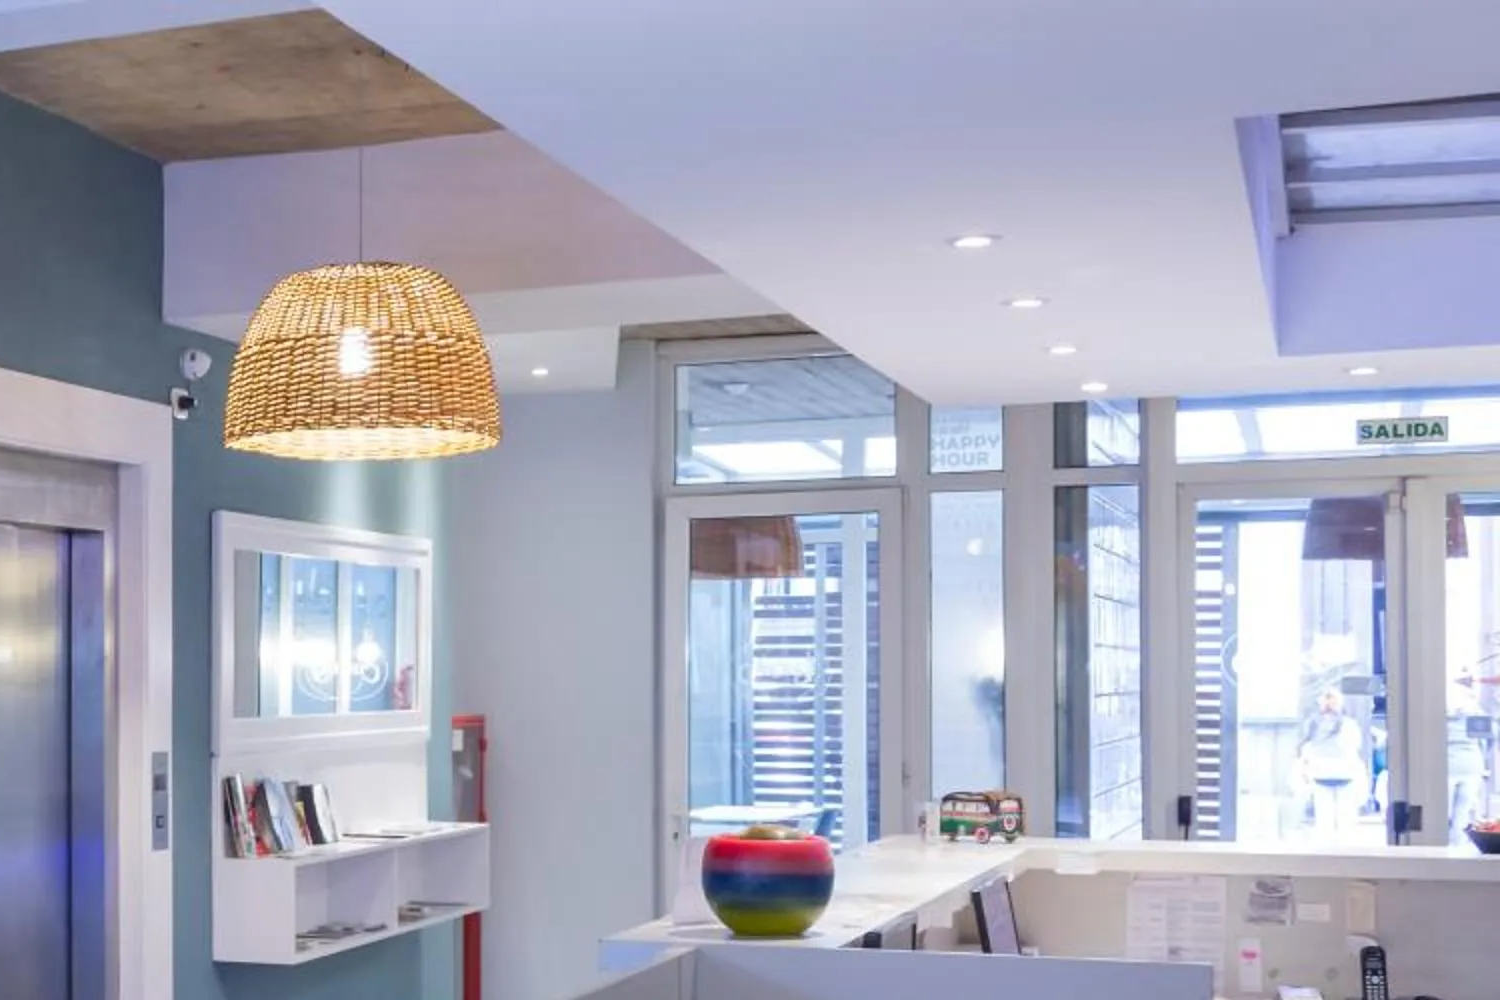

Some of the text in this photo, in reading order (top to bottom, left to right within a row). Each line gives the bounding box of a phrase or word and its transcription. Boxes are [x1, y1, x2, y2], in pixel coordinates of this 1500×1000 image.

[1360, 422, 1444, 439] SALIDA
[931, 433, 1000, 451] HAPPY
[931, 451, 989, 467] HOUR
